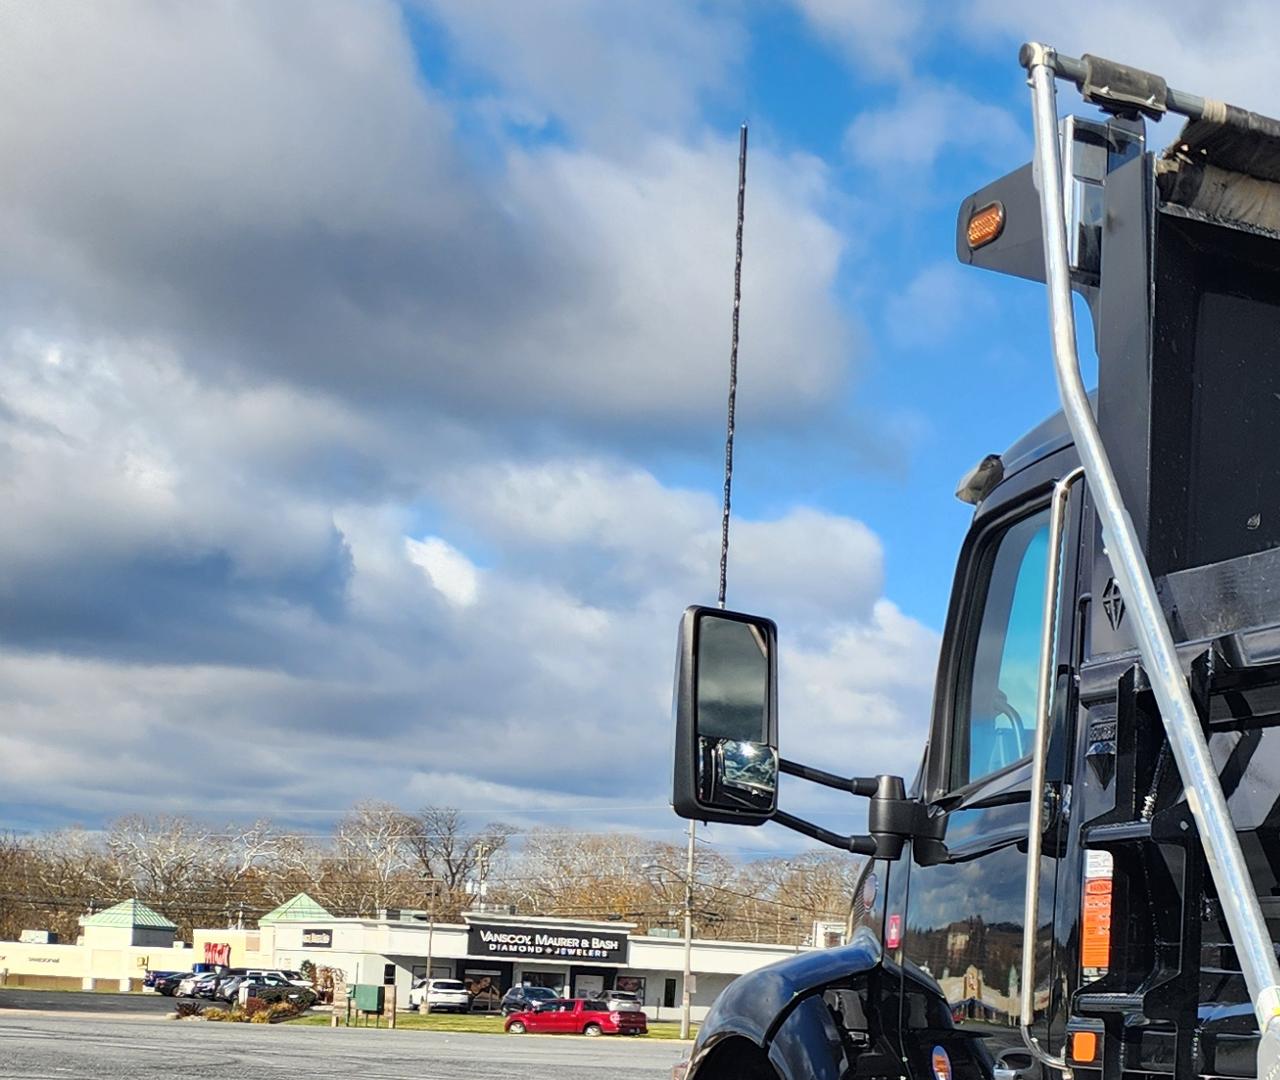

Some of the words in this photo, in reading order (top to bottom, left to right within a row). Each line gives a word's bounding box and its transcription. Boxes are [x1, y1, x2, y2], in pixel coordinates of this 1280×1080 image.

[535, 934, 579, 948] MAURER
[580, 938, 590, 948] &
[591, 937, 618, 950] BASH
[489, 943, 542, 954] DIAMOND
[554, 949, 608, 958] JEWELERS
